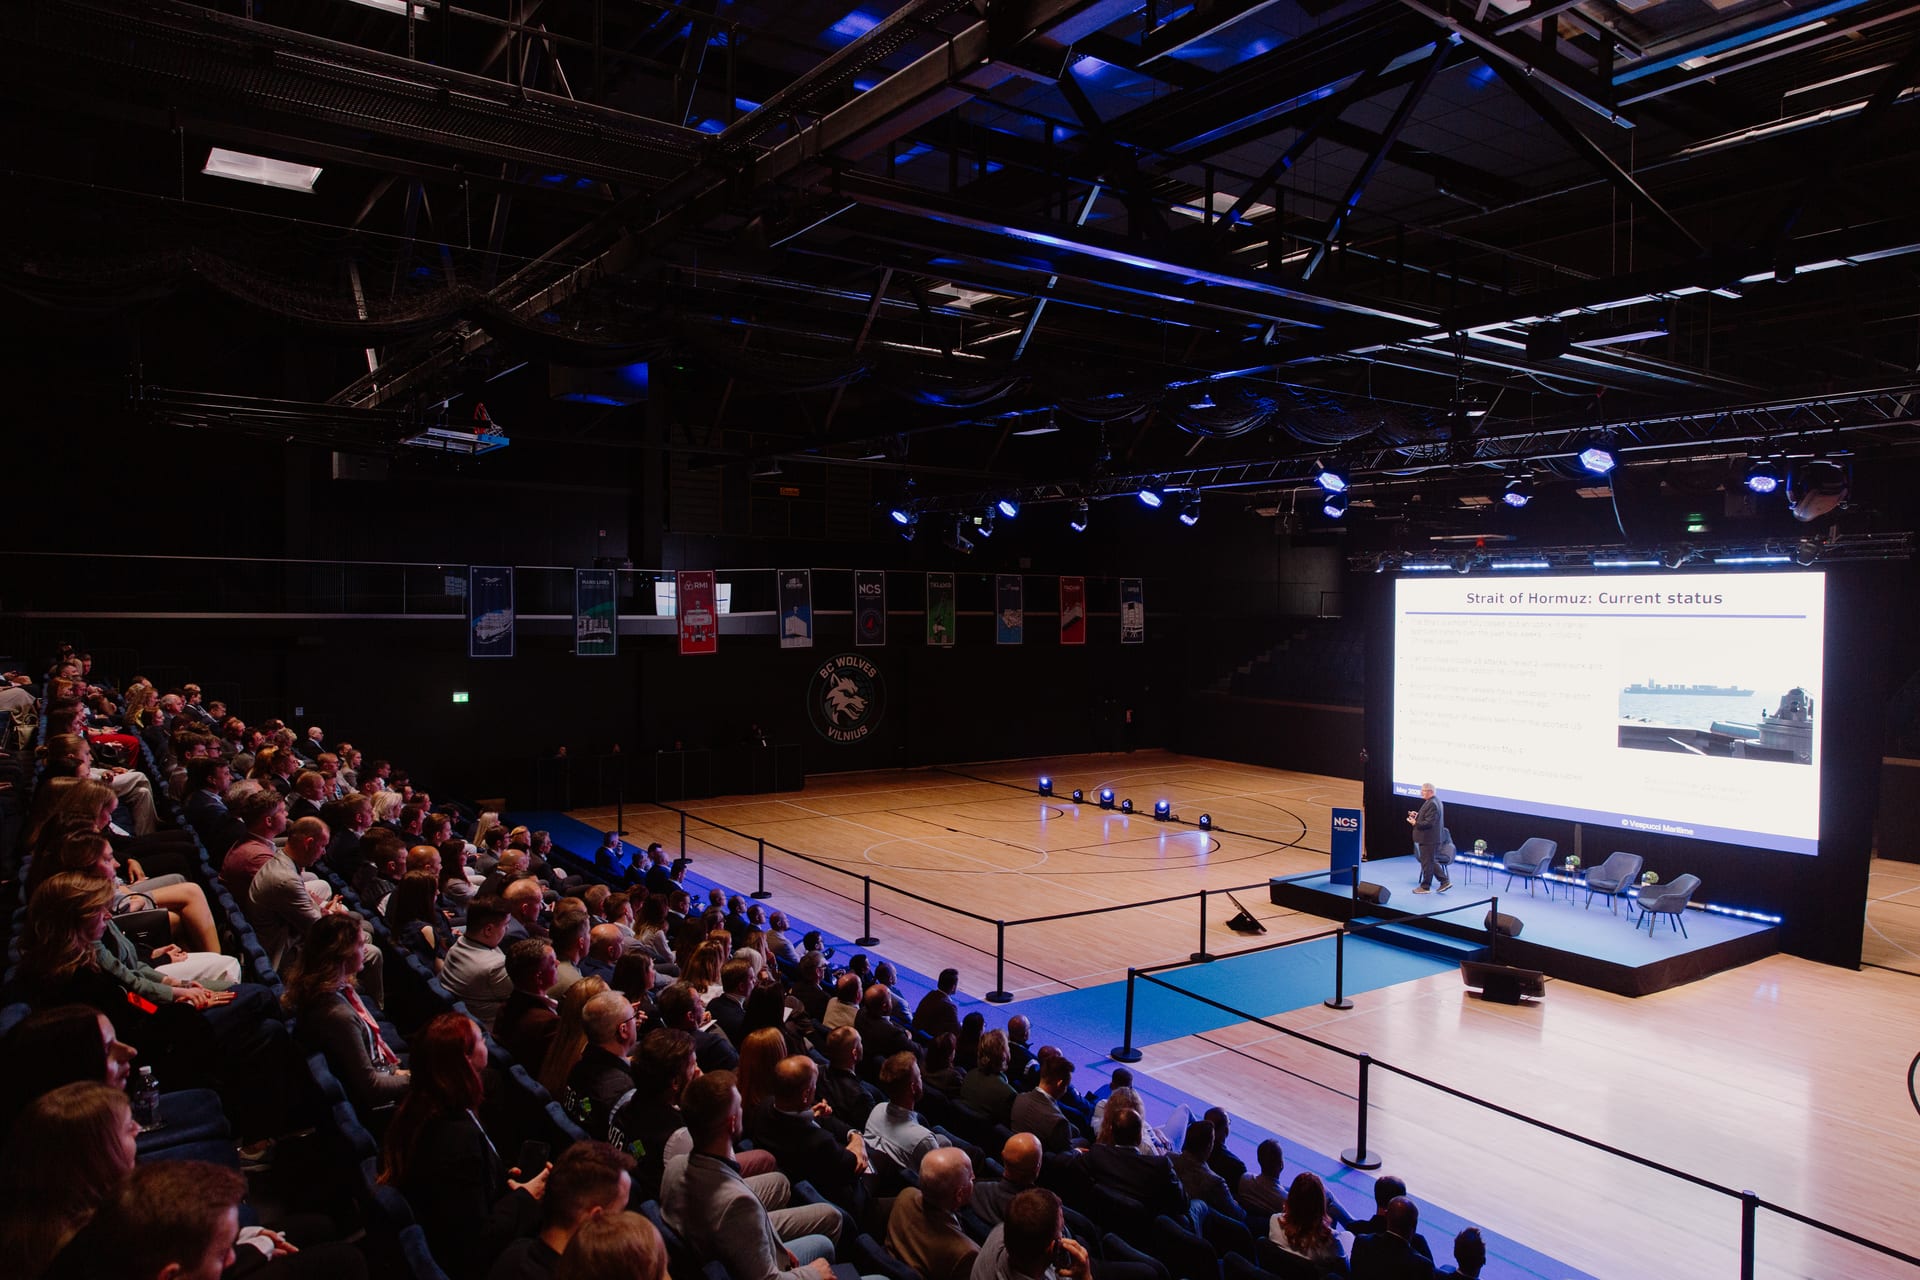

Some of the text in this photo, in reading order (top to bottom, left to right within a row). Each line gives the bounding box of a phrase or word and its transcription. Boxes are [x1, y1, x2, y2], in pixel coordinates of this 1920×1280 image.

[694, 581, 709, 589] RMI
[858, 583, 881, 594] NCS
[1466, 592, 1723, 605] Strait of Hormuz: Current status
[819, 656, 878, 680] BC WOLVES
[827, 724, 869, 741] VILNIUS
[1333, 816, 1358, 828] NCS
[1629, 819, 1662, 833] Vespucci
[1662, 824, 1695, 836] Maritime
